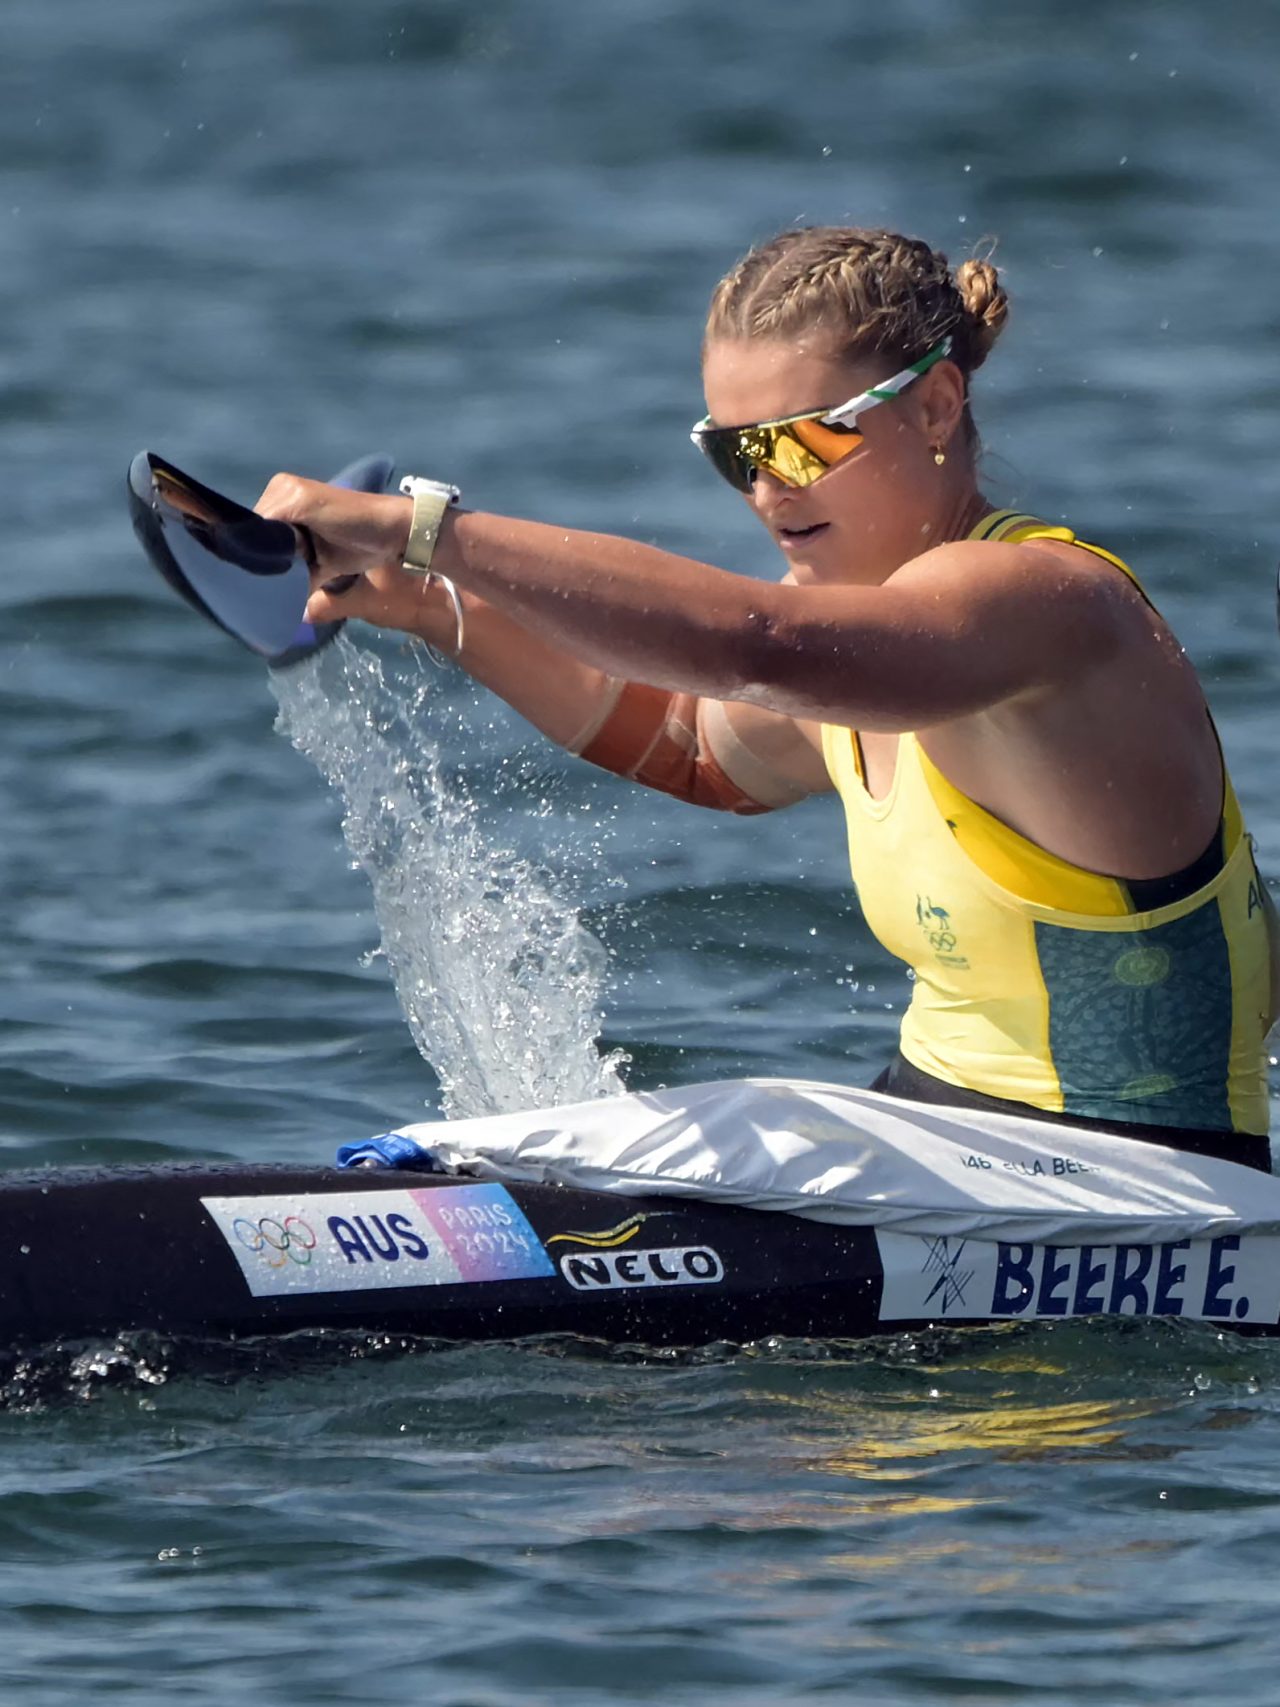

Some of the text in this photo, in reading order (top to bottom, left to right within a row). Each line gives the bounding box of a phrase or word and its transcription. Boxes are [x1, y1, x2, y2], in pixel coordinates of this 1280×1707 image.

[438, 1203, 512, 1230] PARIS
[327, 1212, 430, 1264] AUS
[455, 1230, 530, 1255] 2024
[568, 1250, 718, 1287] NELO
[990, 1235, 1250, 1319] BEERE E.
